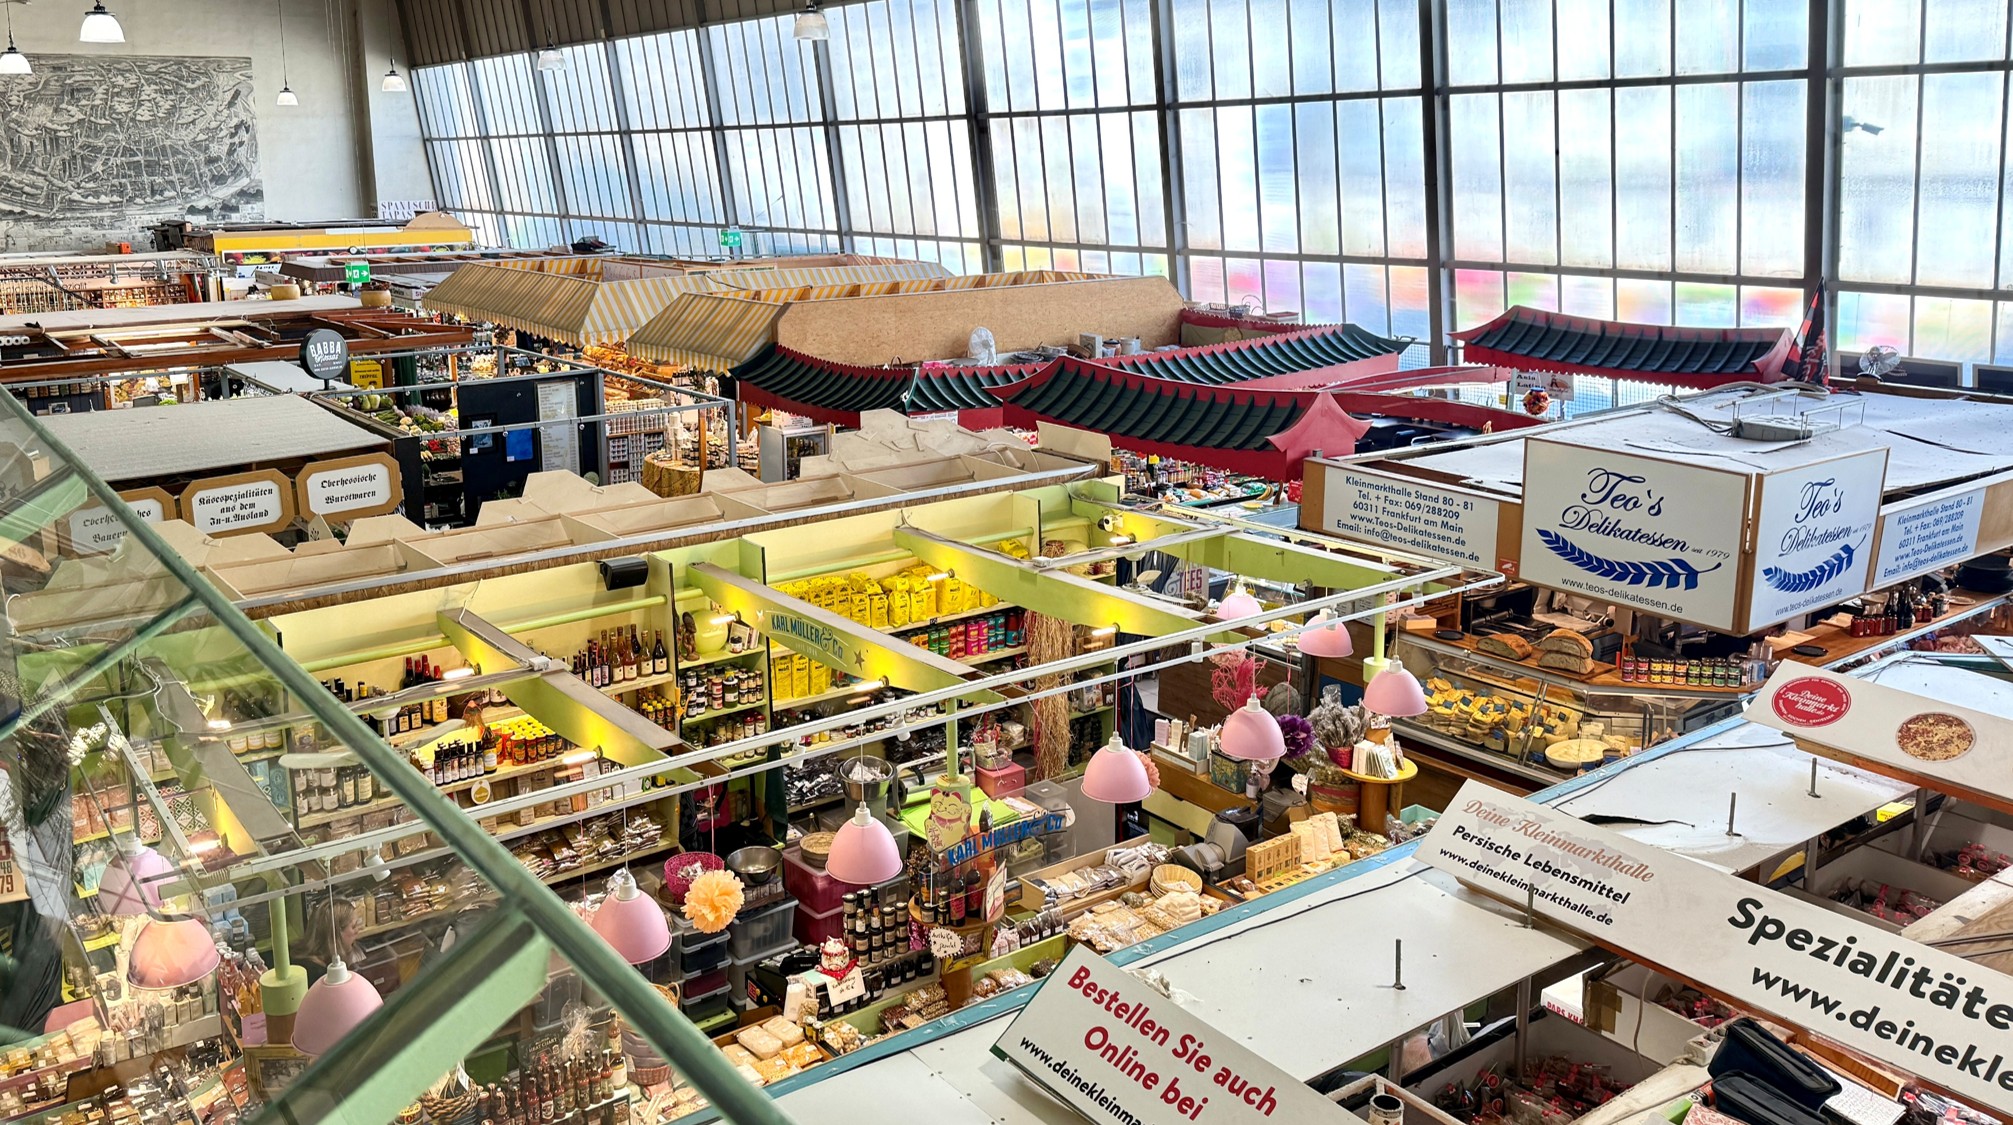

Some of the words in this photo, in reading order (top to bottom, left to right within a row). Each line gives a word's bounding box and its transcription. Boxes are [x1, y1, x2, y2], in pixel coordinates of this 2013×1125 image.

[309, 341, 341, 358] BABBA
[320, 473, 377, 489] Oberhessische
[1345, 475, 1412, 498] Kleinmarkthalle
[1414, 490, 1439, 504] Stand
[1442, 496, 1454, 507] 80
[1463, 500, 1474, 512] 81
[198, 488, 273, 506] Käsespezialitäten
[220, 504, 236, 514] aus
[239, 502, 256, 511] dem
[324, 490, 376, 504] Wurstwaren
[1357, 490, 1372, 501] Tel.
[1375, 494, 1382, 502] +
[1384, 496, 1402, 508] Fax:
[1404, 500, 1460, 521] 069/288209
[1353, 501, 1378, 514] 60311
[1382, 506, 1422, 524] Frankfurt
[1424, 517, 1438, 528] am
[1440, 520, 1464, 534] Main
[1897, 507, 1940, 526] Kleinmarkthalle
[1940, 502, 1955, 514] Stand
[1919, 521, 1932, 532] Fax:
[1336, 519, 1362, 534] Email:
[1364, 526, 1480, 563] info@teos-delikatessen.de
[1350, 513, 1466, 547] www.Teos-Delikatessen.de
[1558, 505, 1690, 553] Delikatessen
[1705, 549, 1731, 560] 1979
[1778, 525, 1852, 557] Delikatessen
[1898, 536, 1916, 550] 60311
[1916, 529, 1941, 544] Frankfurt
[1941, 528, 1950, 536] am
[1950, 523, 1964, 534] Main
[1883, 565, 1901, 578] Email:
[1561, 576, 1684, 614] www.teos-delikatessen.de
[1775, 587, 1843, 616] www.teos-delikatessen.de
[771, 614, 789, 632] KARL
[790, 617, 820, 645] MÜLLER
[1782, 691, 1840, 712] Kleinmarkt
[1800, 690, 1826, 703] Deine
[947, 837, 979, 866] KARL
[1461, 799, 1511, 828] Deine
[1512, 819, 1655, 883] Kleinmarkthalle
[1452, 824, 1521, 861] Persische
[1523, 853, 1631, 905] Lebensmittel
[1439, 848, 1613, 926] www.deinekleinmarkthalle.de
[1067, 965, 1170, 1047] Bestellen
[1171, 1033, 1212, 1073] Sie
[1213, 1066, 1277, 1117] auch
[1084, 1026, 1160, 1090] Online
[1160, 1077, 1209, 1121] bei
